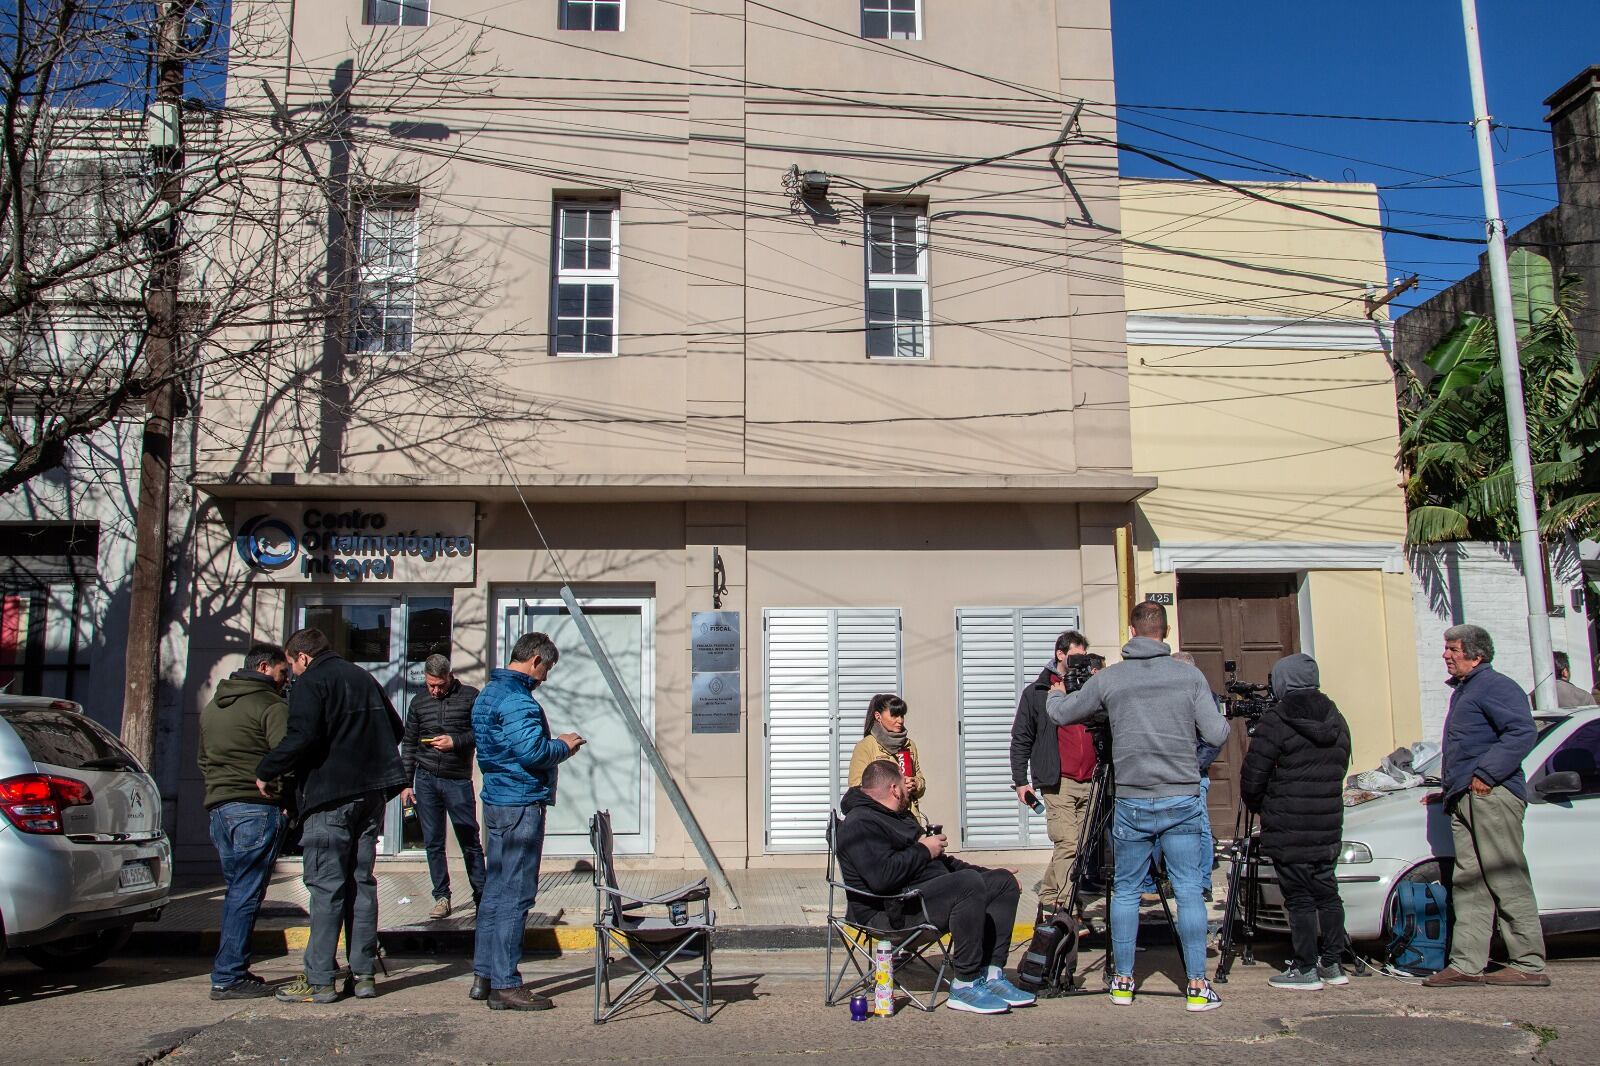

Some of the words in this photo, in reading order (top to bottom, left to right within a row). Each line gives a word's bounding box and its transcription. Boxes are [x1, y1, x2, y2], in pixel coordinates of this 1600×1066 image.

[303, 508, 386, 529] Centro
[302, 530, 473, 562] Oftalmológico
[301, 554, 394, 581] Integral
[1150, 593, 1170, 603] 425
[1098, 740, 1104, 750] 5
